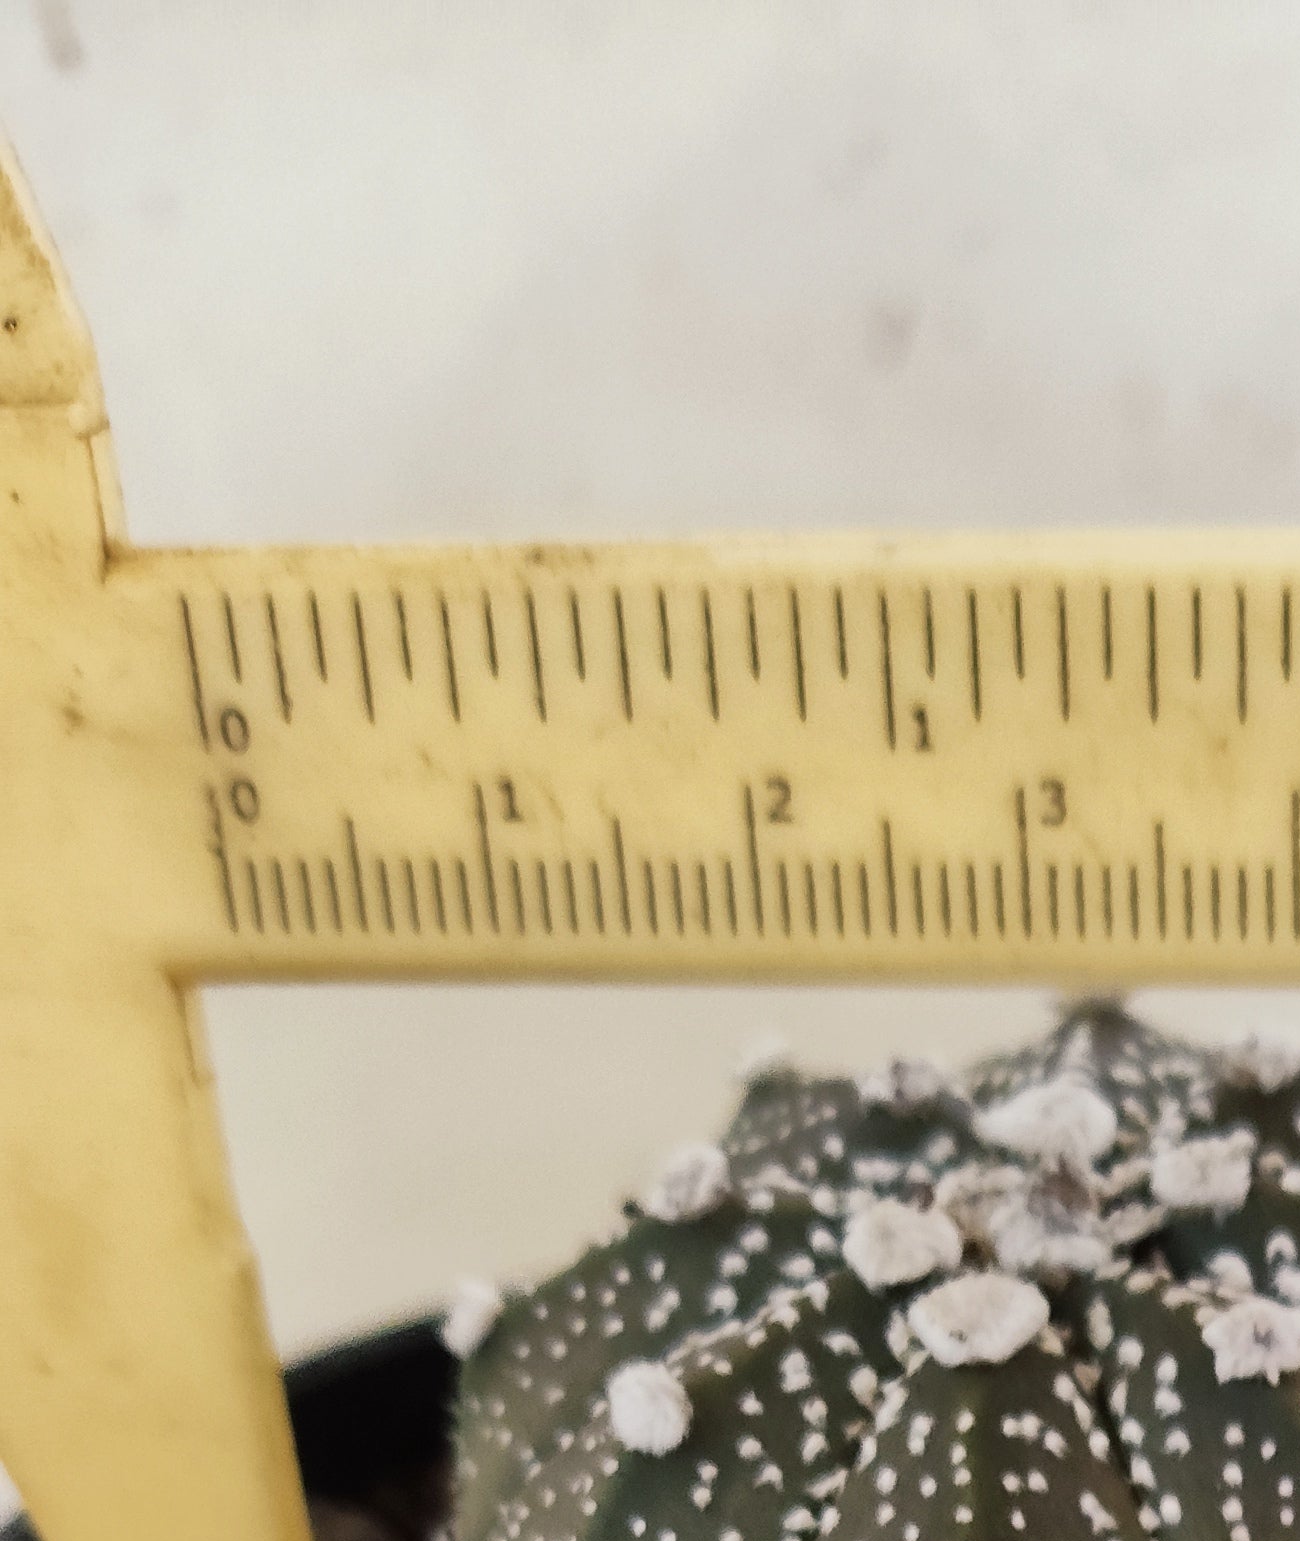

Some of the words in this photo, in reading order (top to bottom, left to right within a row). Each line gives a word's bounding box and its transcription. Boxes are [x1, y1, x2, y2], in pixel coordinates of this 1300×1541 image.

[219, 709, 250, 754] 0
[912, 704, 934, 753] 1
[230, 779, 261, 824] 0
[497, 777, 524, 824] 1
[765, 778, 795, 825] 2
[1040, 779, 1068, 827] 3
